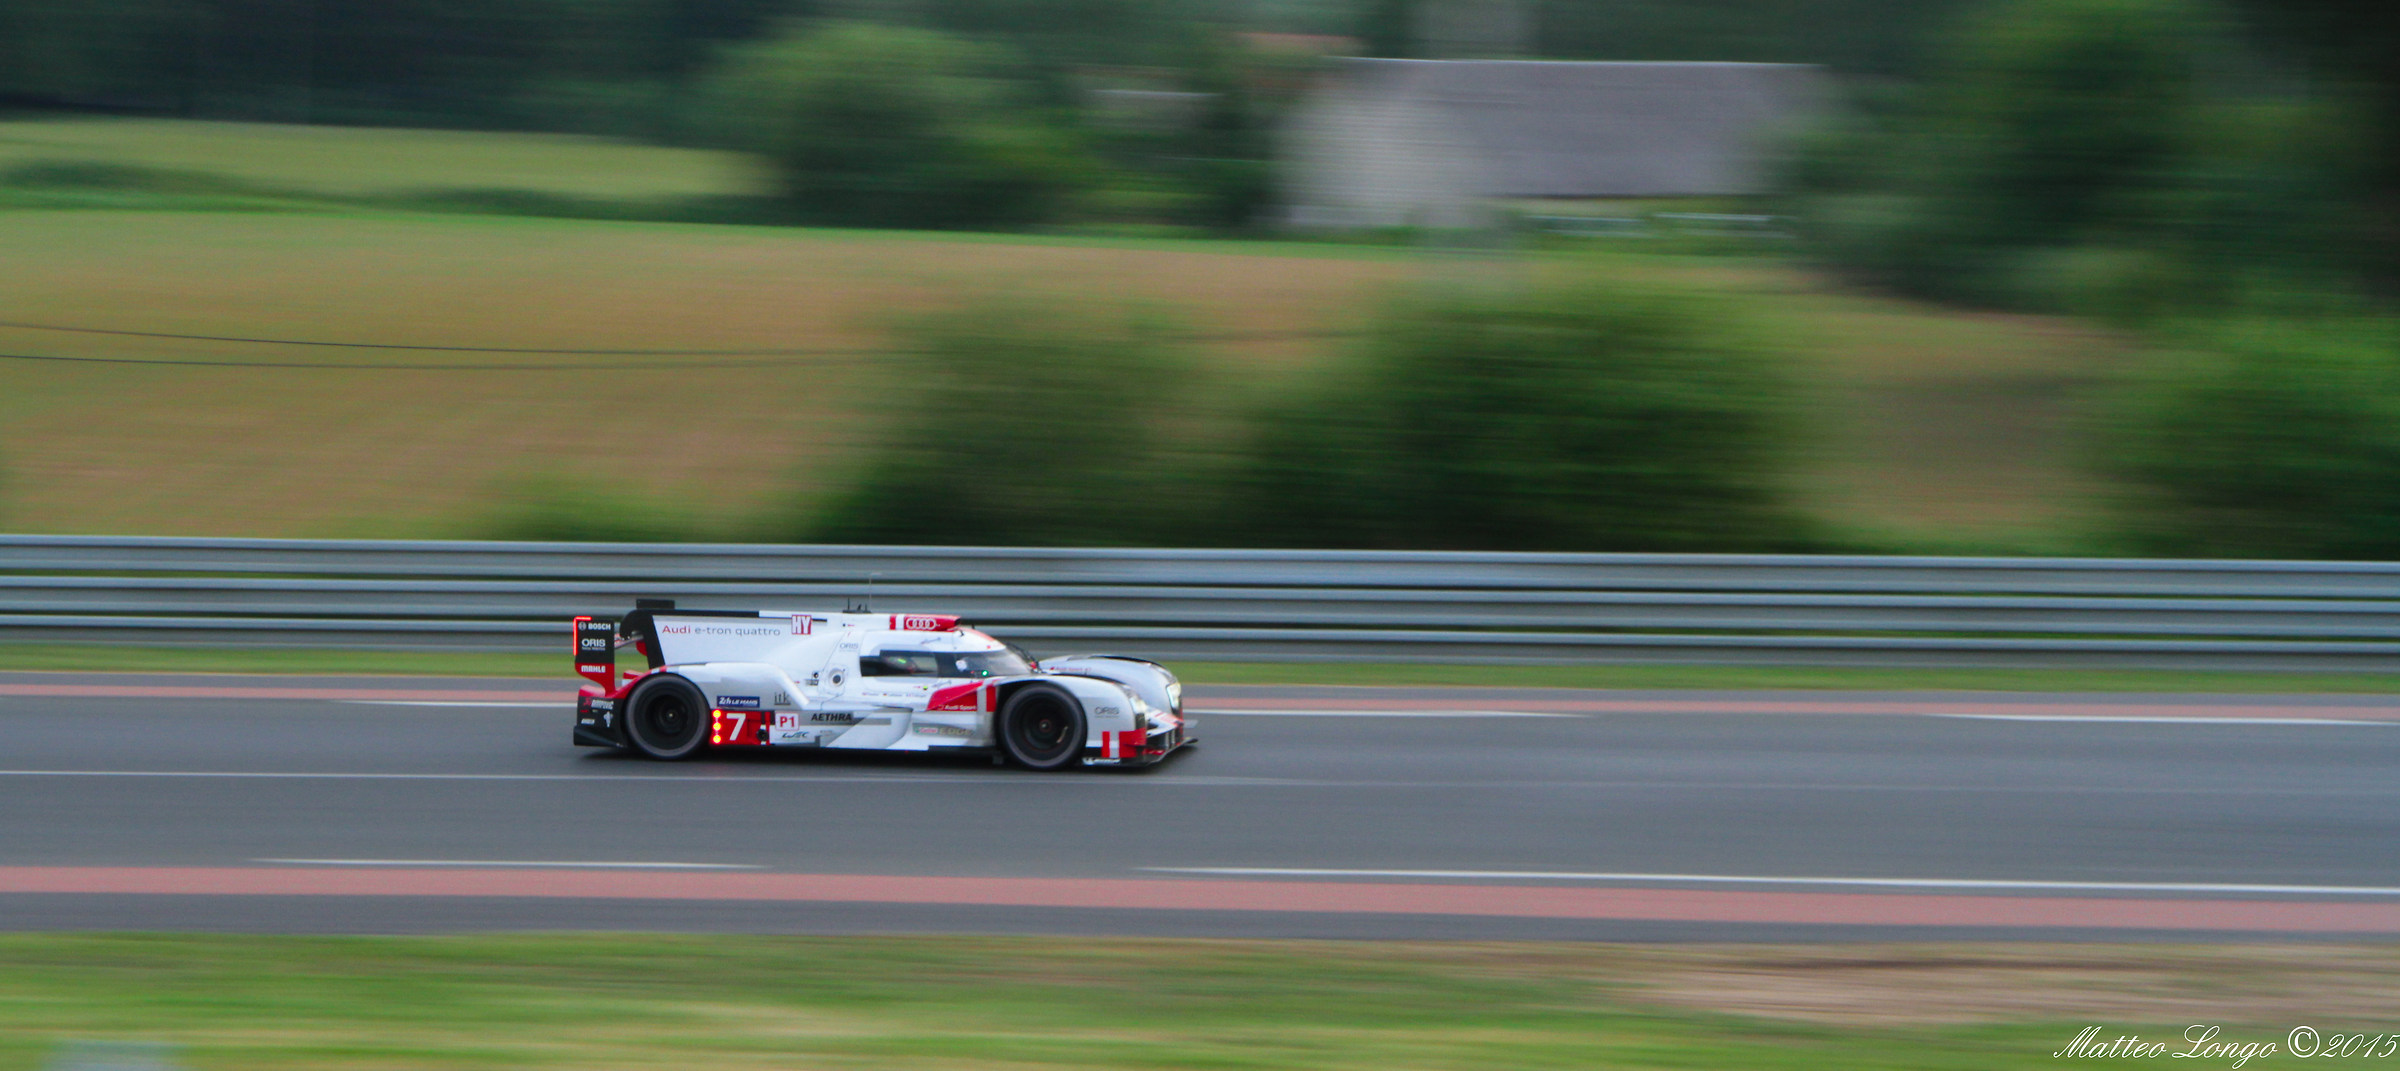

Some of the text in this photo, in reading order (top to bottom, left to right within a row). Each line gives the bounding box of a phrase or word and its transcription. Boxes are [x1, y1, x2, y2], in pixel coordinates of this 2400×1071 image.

[791, 614, 812, 635] HY
[662, 625, 781, 636] Audi e-tron quattro
[581, 638, 606, 647] ORIS
[581, 665, 606, 673] MAHLE
[1094, 706, 1119, 715] ORIS
[779, 716, 795, 728] P1
[811, 713, 853, 721] AETHRA
[726, 713, 746, 741] 7
